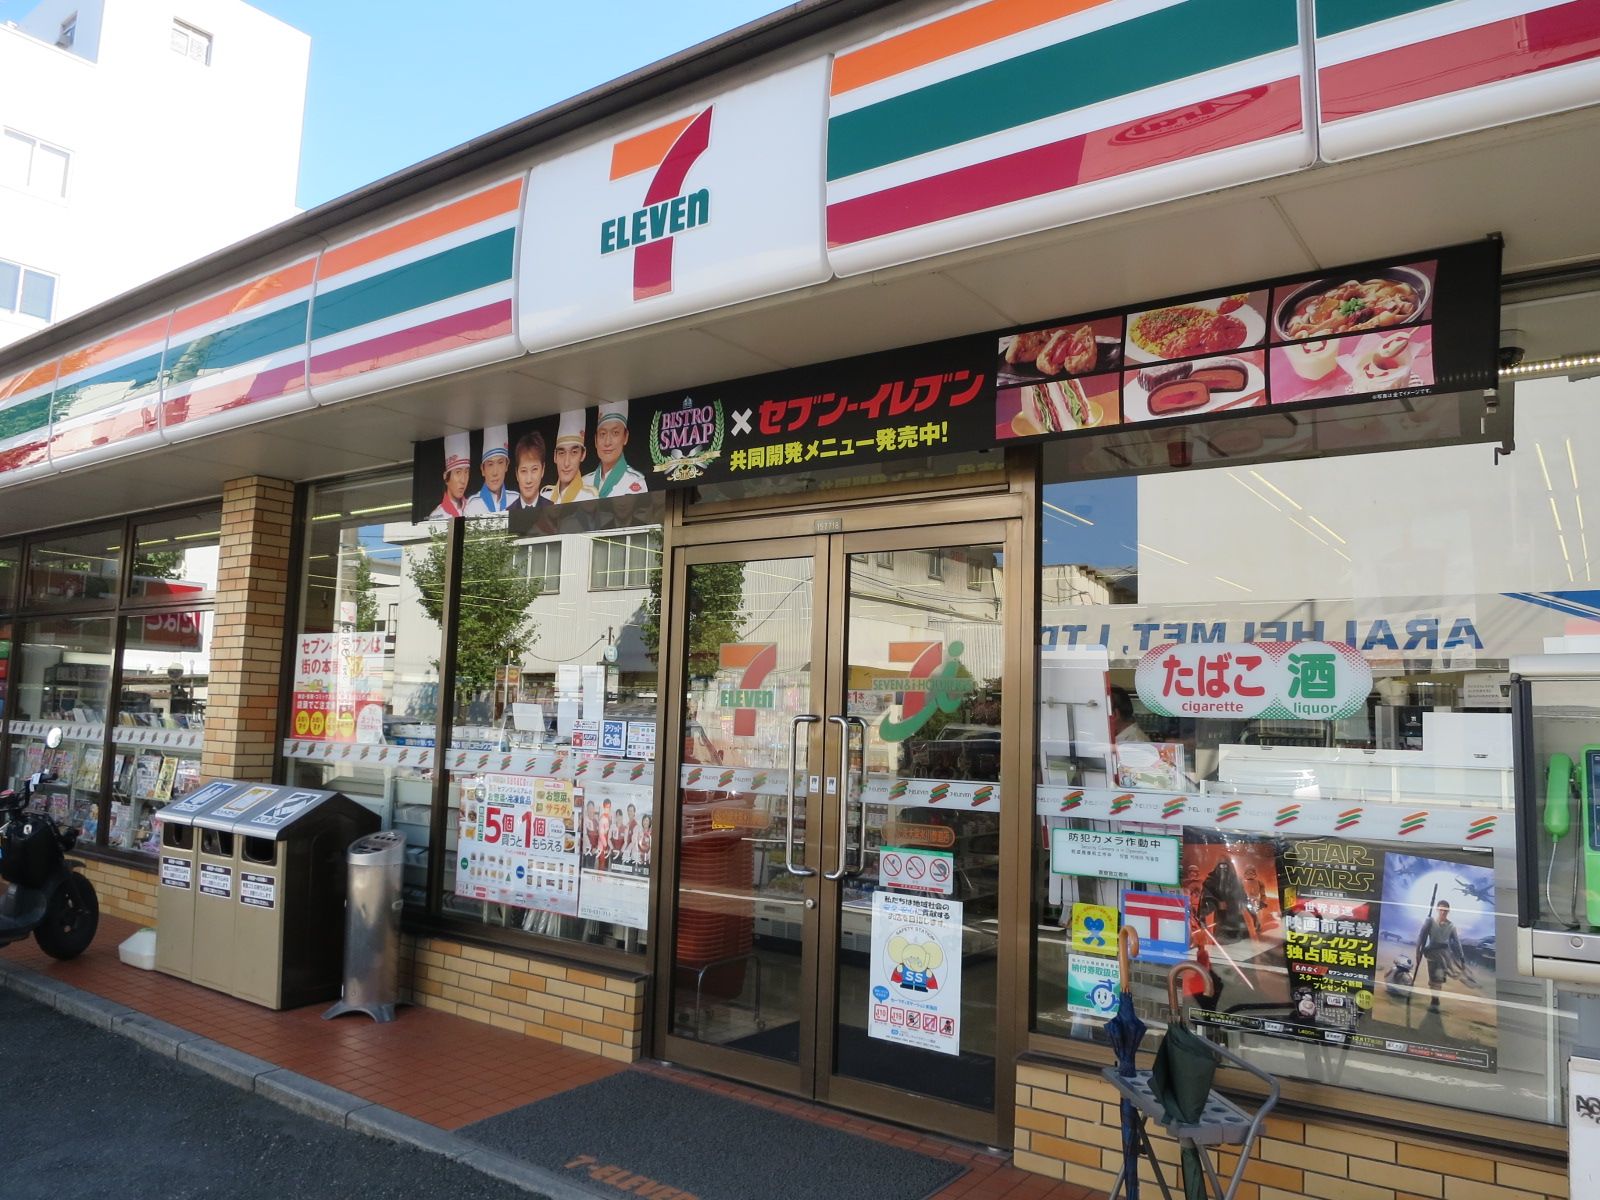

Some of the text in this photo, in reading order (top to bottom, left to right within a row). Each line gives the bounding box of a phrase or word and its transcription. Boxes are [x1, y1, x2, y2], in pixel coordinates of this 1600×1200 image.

[758, 369, 985, 436] セブン-イレブン
[661, 405, 714, 430] BISTRO
[659, 422, 715, 451] SMAP
[729, 420, 949, 472] 共同開発メニュー発売中!
[1162, 652, 1337, 699] たばこ 酒
[1181, 700, 1338, 716] cigarette liquor
[1068, 832, 1161, 849] 防犯カメラ作動中
[1283, 841, 1375, 867] STAR
[1284, 865, 1375, 892] WARS
[884, 895, 950, 911] 私たちは地域社会の
[1285, 915, 1374, 938] 映画前売券
[1286, 944, 1375, 969] 独占販売中
[905, 970, 924, 983] SS
